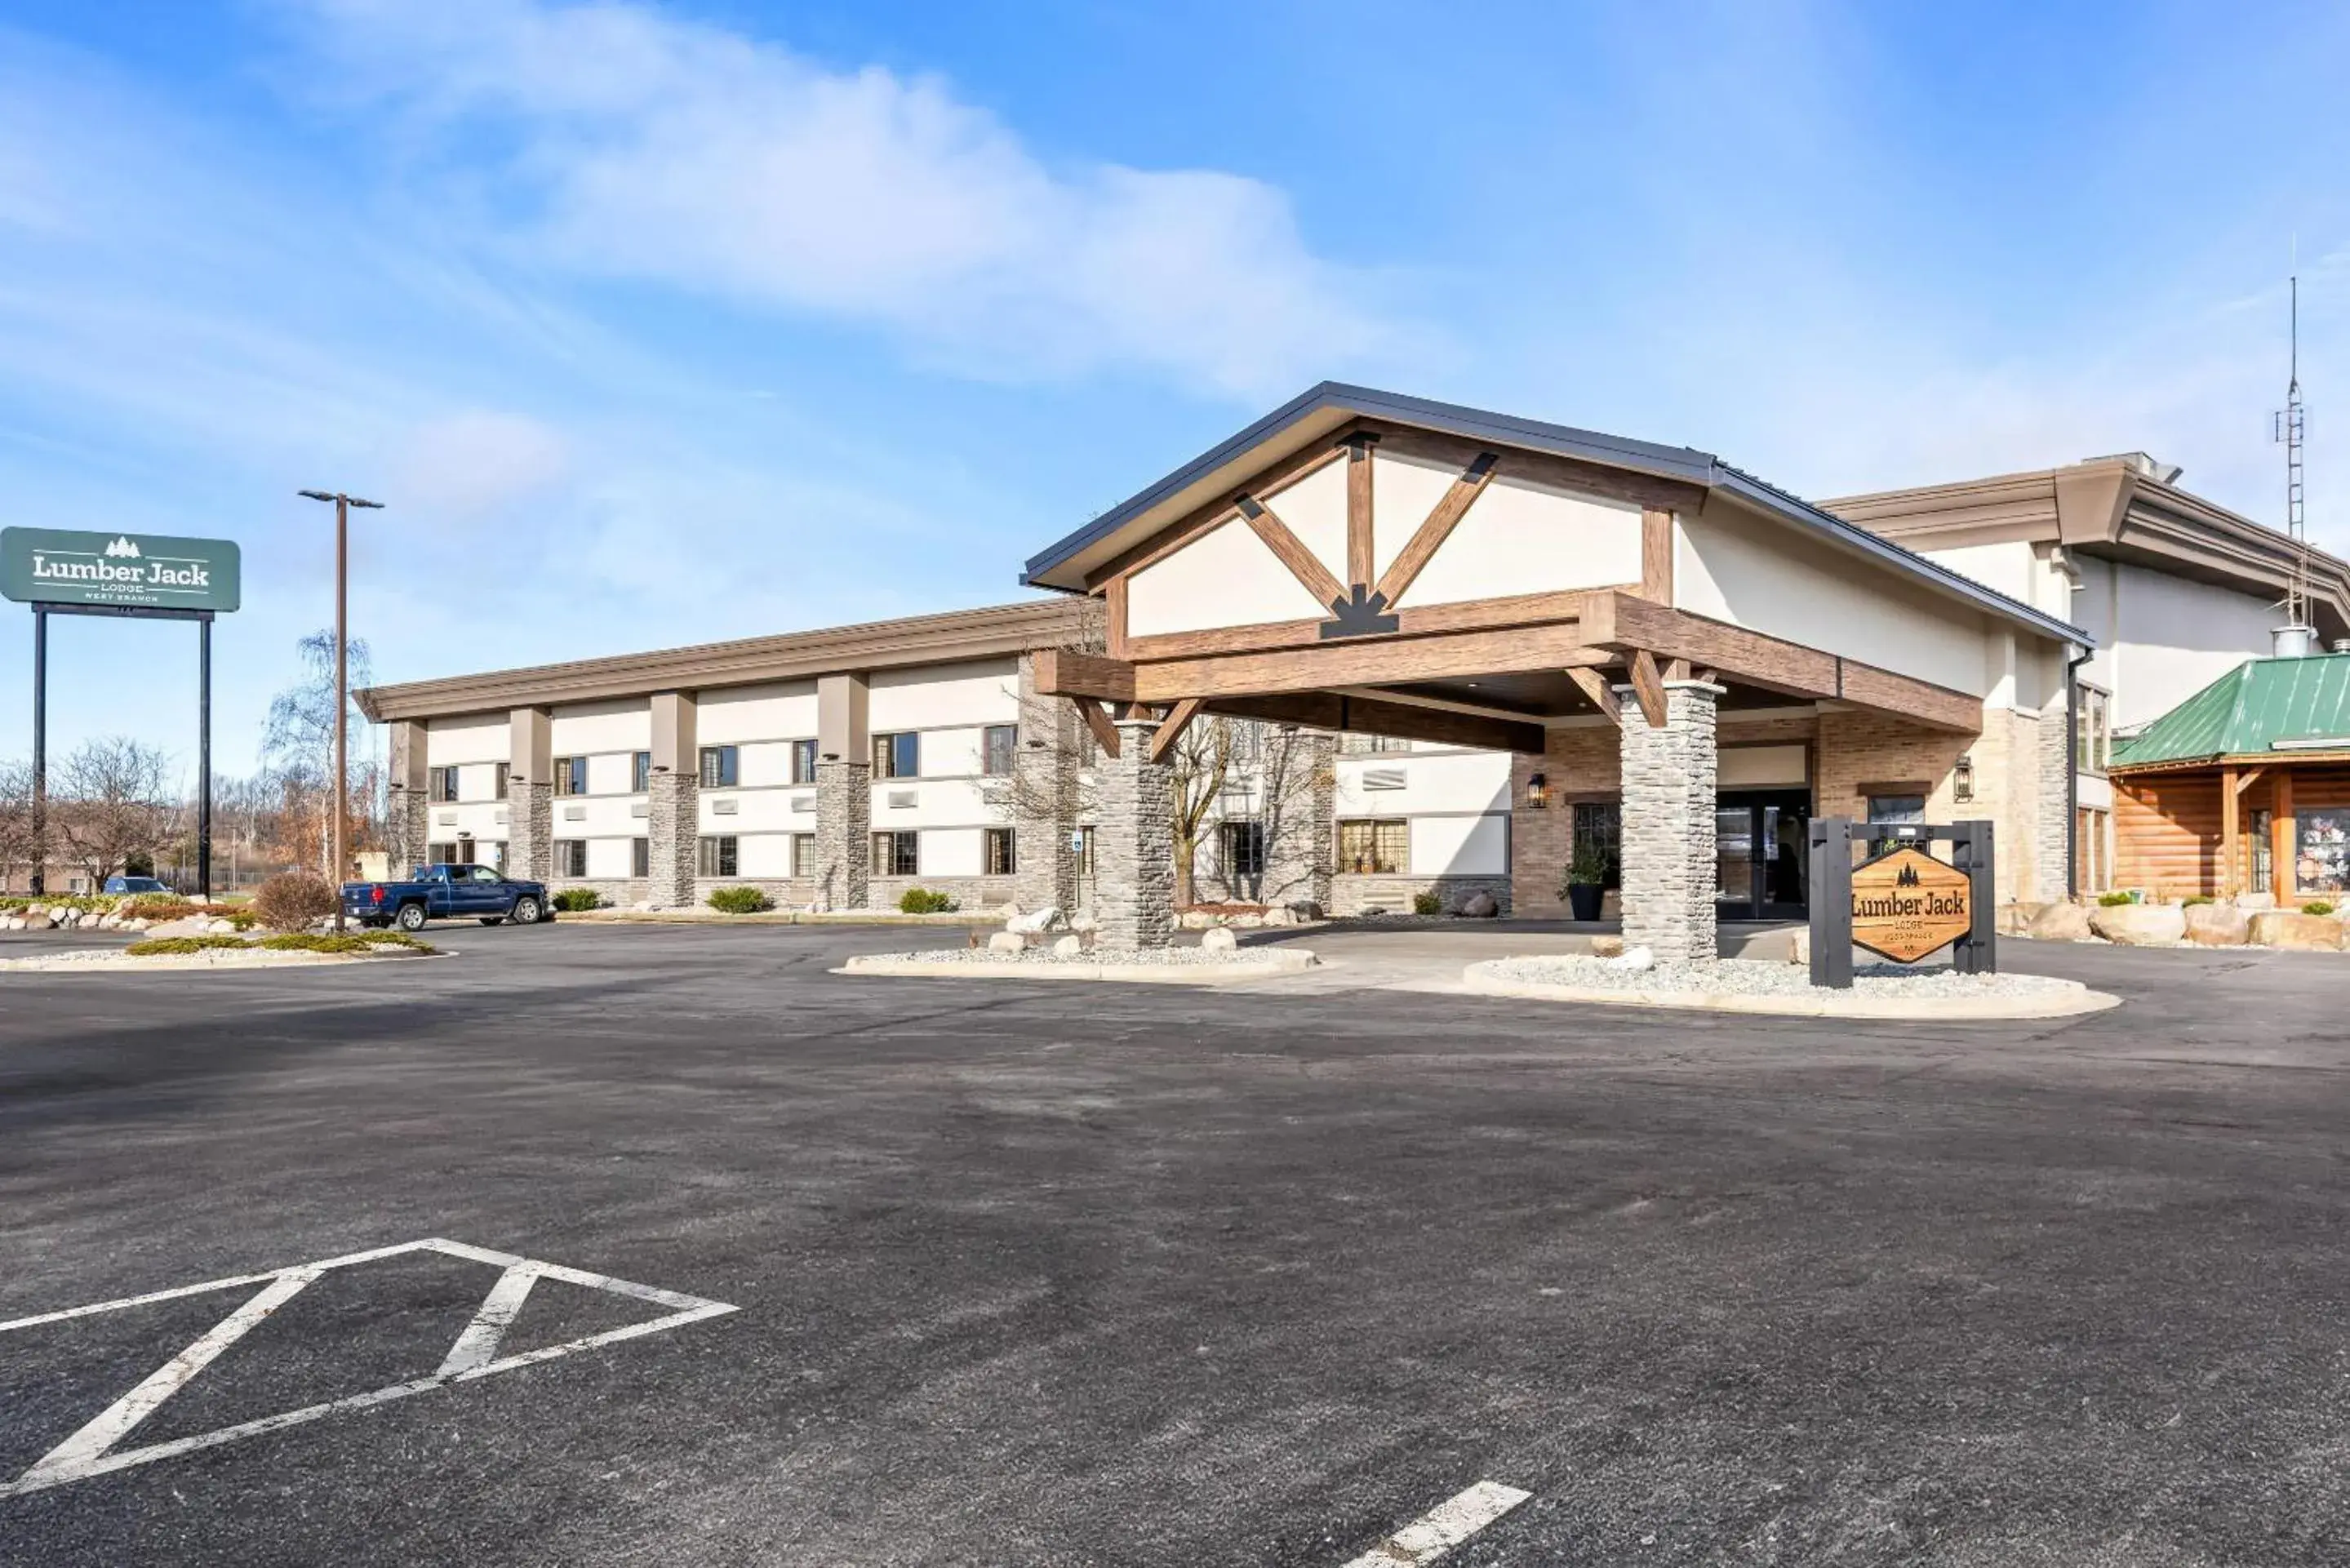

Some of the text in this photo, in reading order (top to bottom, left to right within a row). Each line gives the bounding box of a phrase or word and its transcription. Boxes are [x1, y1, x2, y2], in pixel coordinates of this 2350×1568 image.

[33, 556, 209, 586] Lumber Jack
[100, 584, 144, 593] LODGE
[1851, 890, 1964, 917] Lumber Jack
